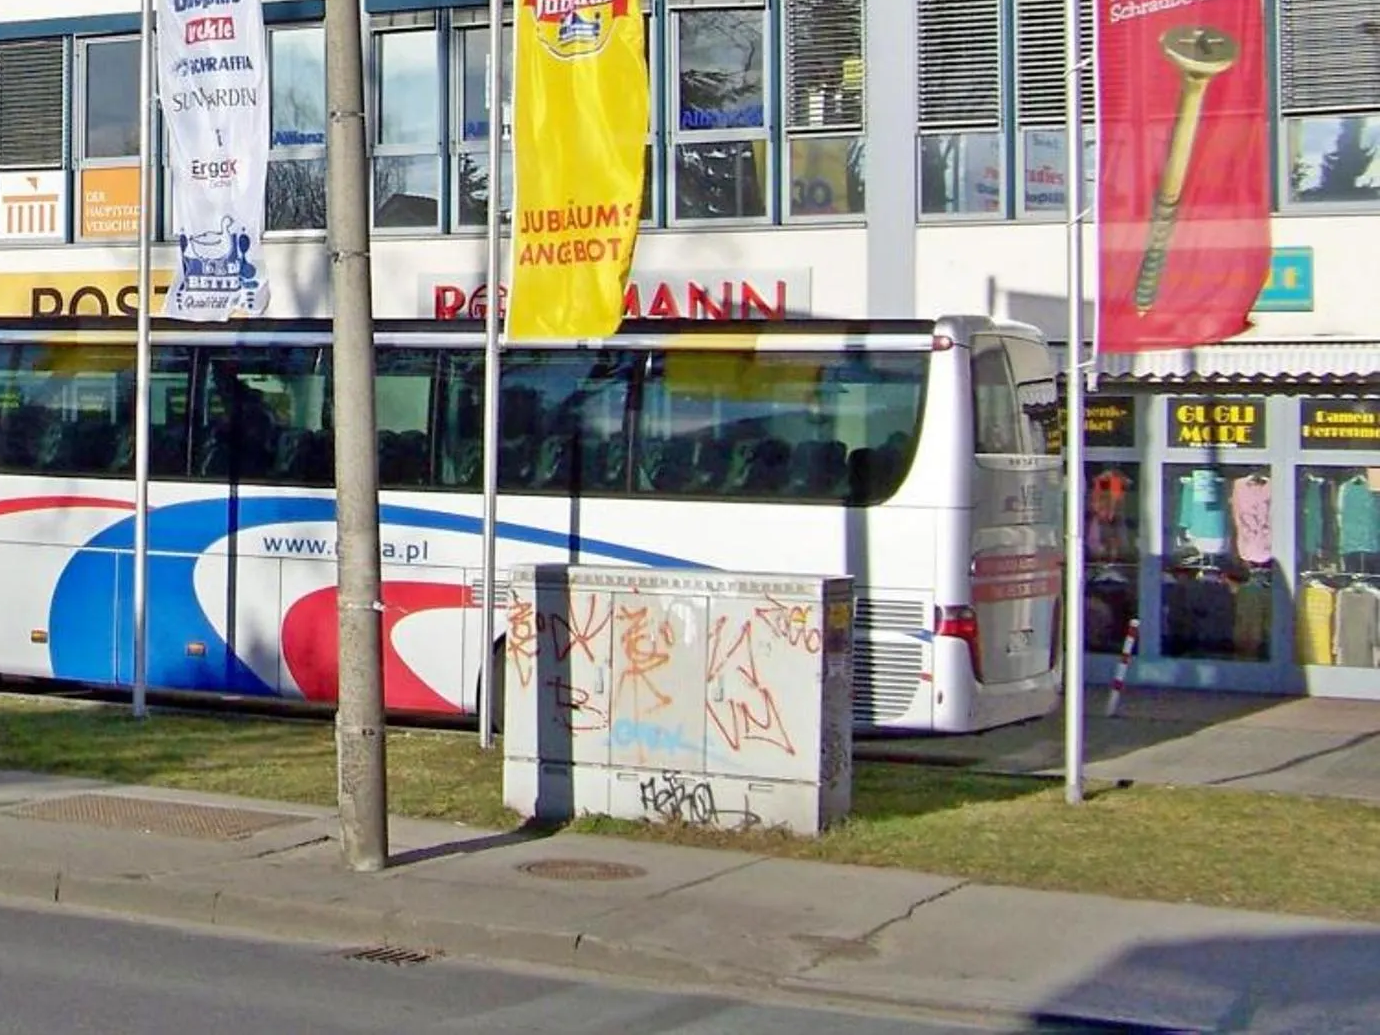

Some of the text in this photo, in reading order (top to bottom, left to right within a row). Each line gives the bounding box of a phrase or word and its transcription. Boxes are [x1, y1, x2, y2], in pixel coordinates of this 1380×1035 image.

[520, 199, 633, 234] JUBÄUM
[434, 279, 786, 319] ROANN
[263, 537, 428, 563] www.a.pl
